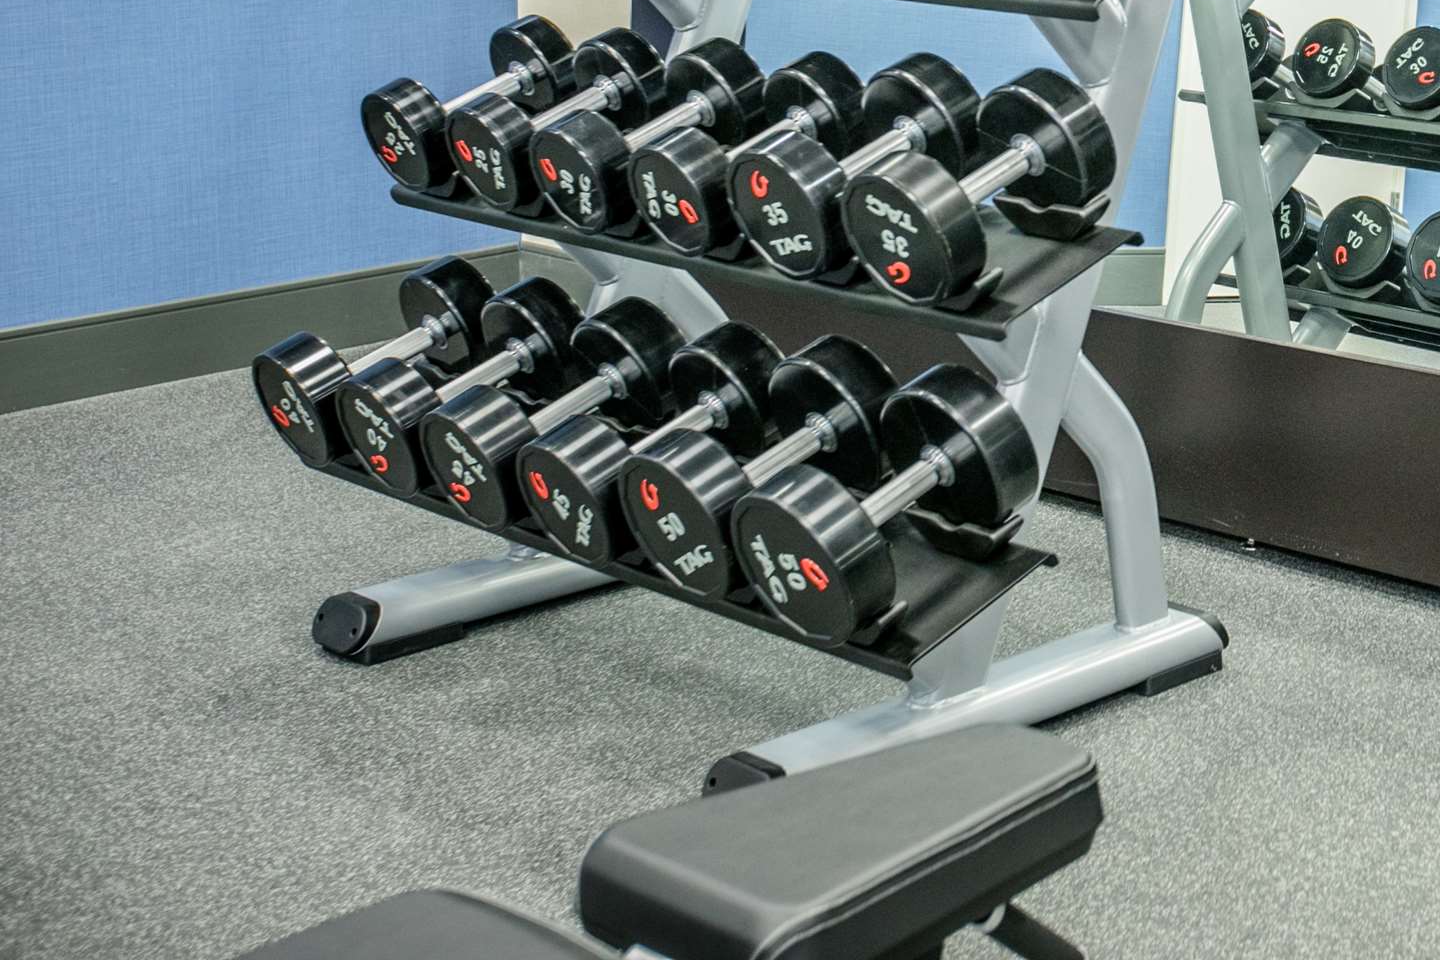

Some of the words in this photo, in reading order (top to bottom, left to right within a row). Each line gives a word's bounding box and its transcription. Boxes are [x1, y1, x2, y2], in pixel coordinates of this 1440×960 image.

[384, 111, 417, 156] TAG
[472, 146, 489, 174] 25
[490, 147, 506, 190] TAG
[559, 169, 575, 195] 30
[578, 173, 593, 215] TAG
[642, 171, 661, 219] TAG
[661, 190, 680, 216] 30
[762, 201, 789, 226] 35
[865, 194, 919, 234] TAG
[769, 234, 813, 256] TAG
[880, 229, 910, 259] 35
[281, 398, 300, 424] 40
[282, 380, 314, 433] TAG
[355, 398, 395, 439] TAG
[366, 428, 387, 452] 40
[445, 432, 487, 482] TAG
[452, 460, 475, 486] 45
[552, 488, 571, 521] 45
[575, 504, 594, 547] TAG
[656, 512, 686, 542] 50
[673, 544, 715, 576] TAG
[751, 534, 788, 604] TAG
[777, 553, 807, 591] 50
